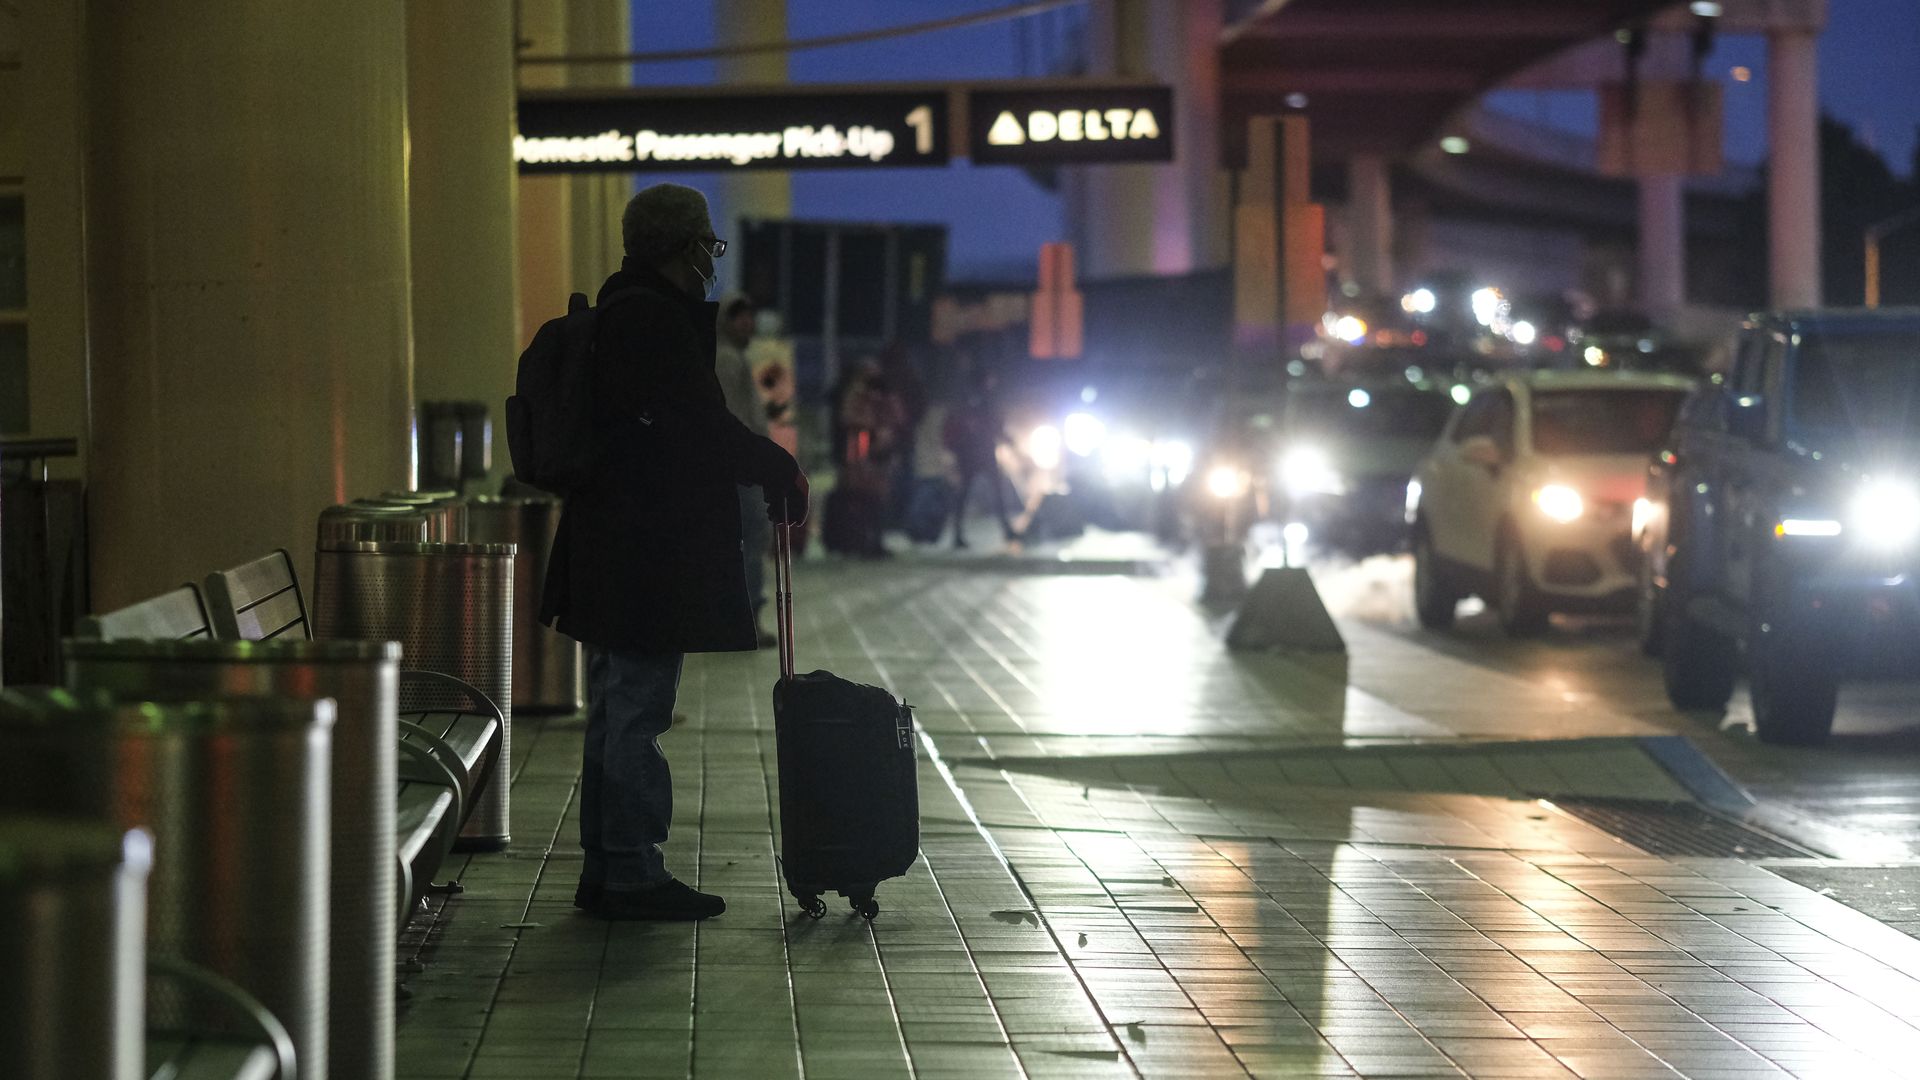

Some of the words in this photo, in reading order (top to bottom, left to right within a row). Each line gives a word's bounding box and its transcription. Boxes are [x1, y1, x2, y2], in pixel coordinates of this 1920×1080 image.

[635, 129, 783, 165] Passenger
[783, 125, 895, 161] Pick-Up
[905, 105, 933, 154] 1
[1028, 108, 1160, 142] DELTA
